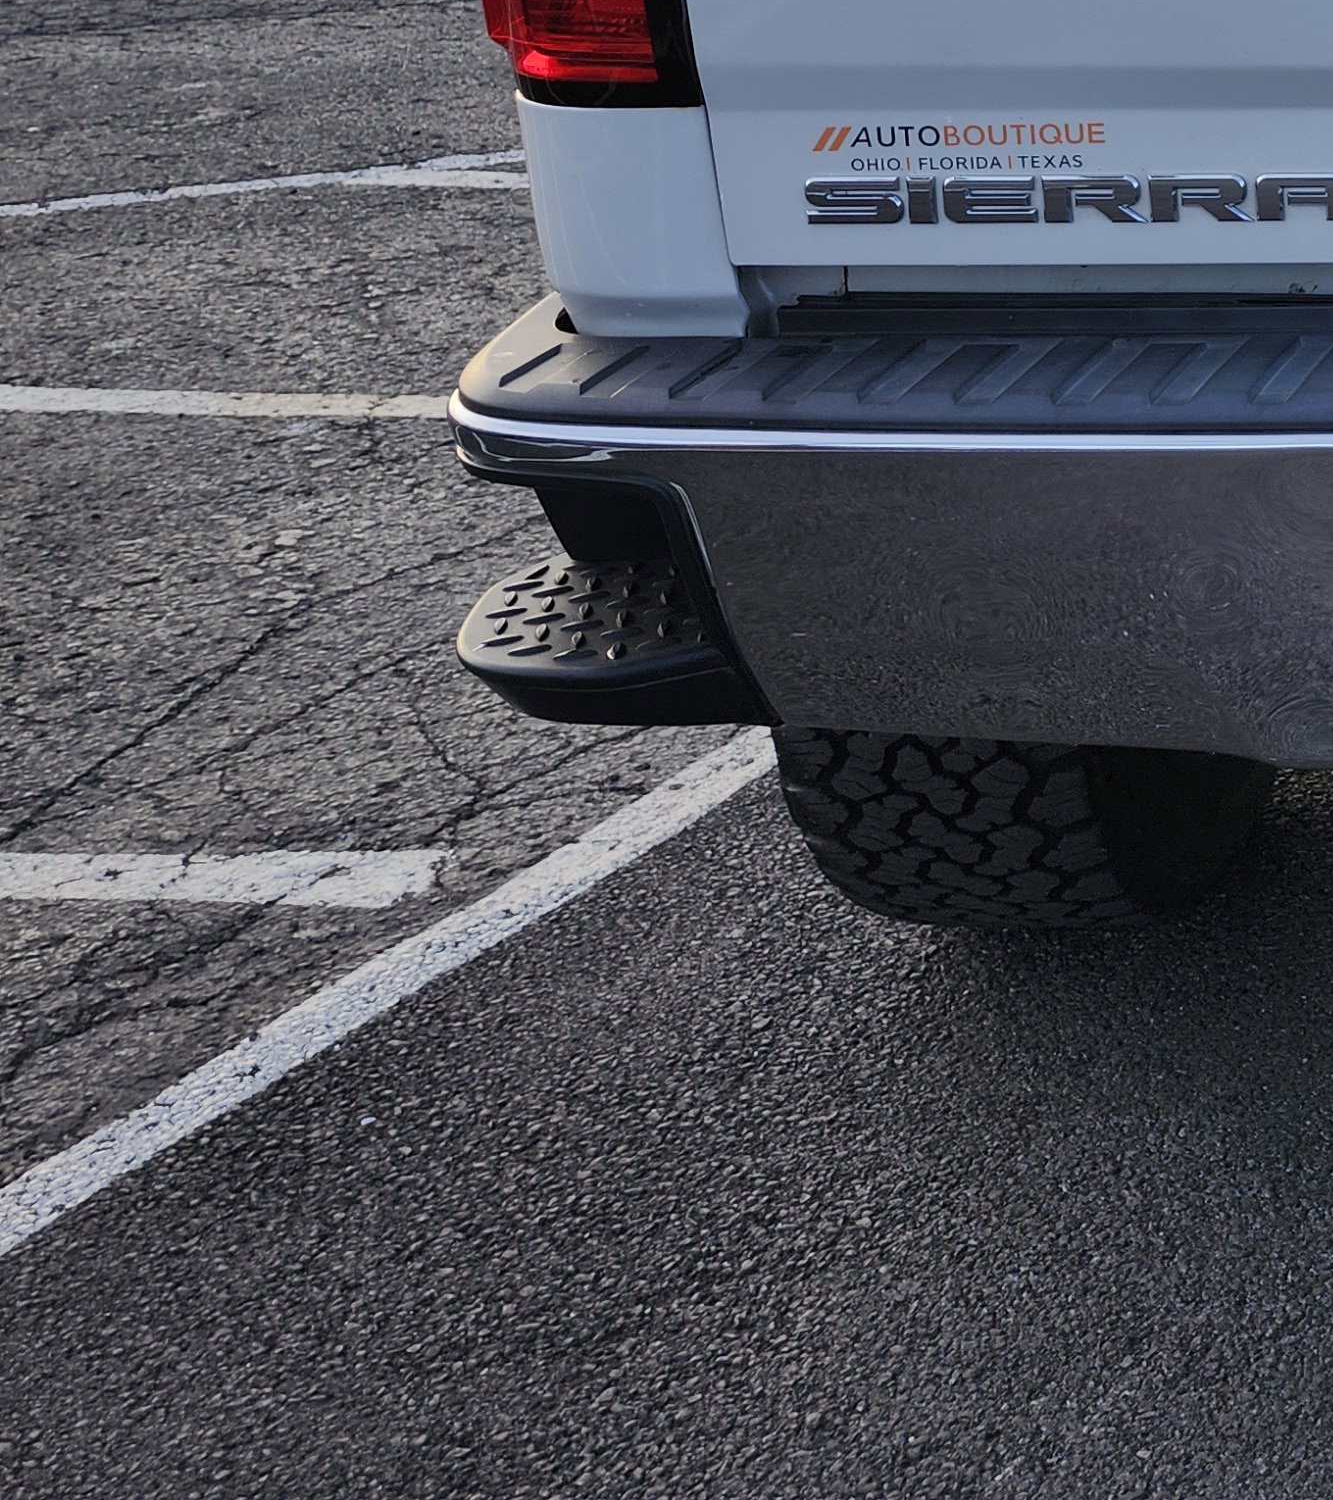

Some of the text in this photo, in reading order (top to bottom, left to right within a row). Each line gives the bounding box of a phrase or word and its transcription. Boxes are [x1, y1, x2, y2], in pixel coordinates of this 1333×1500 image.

[850, 123, 1106, 148] AUTOBOUTIQUE
[850, 154, 1084, 172] OHIO FLORIDA TEXAS
